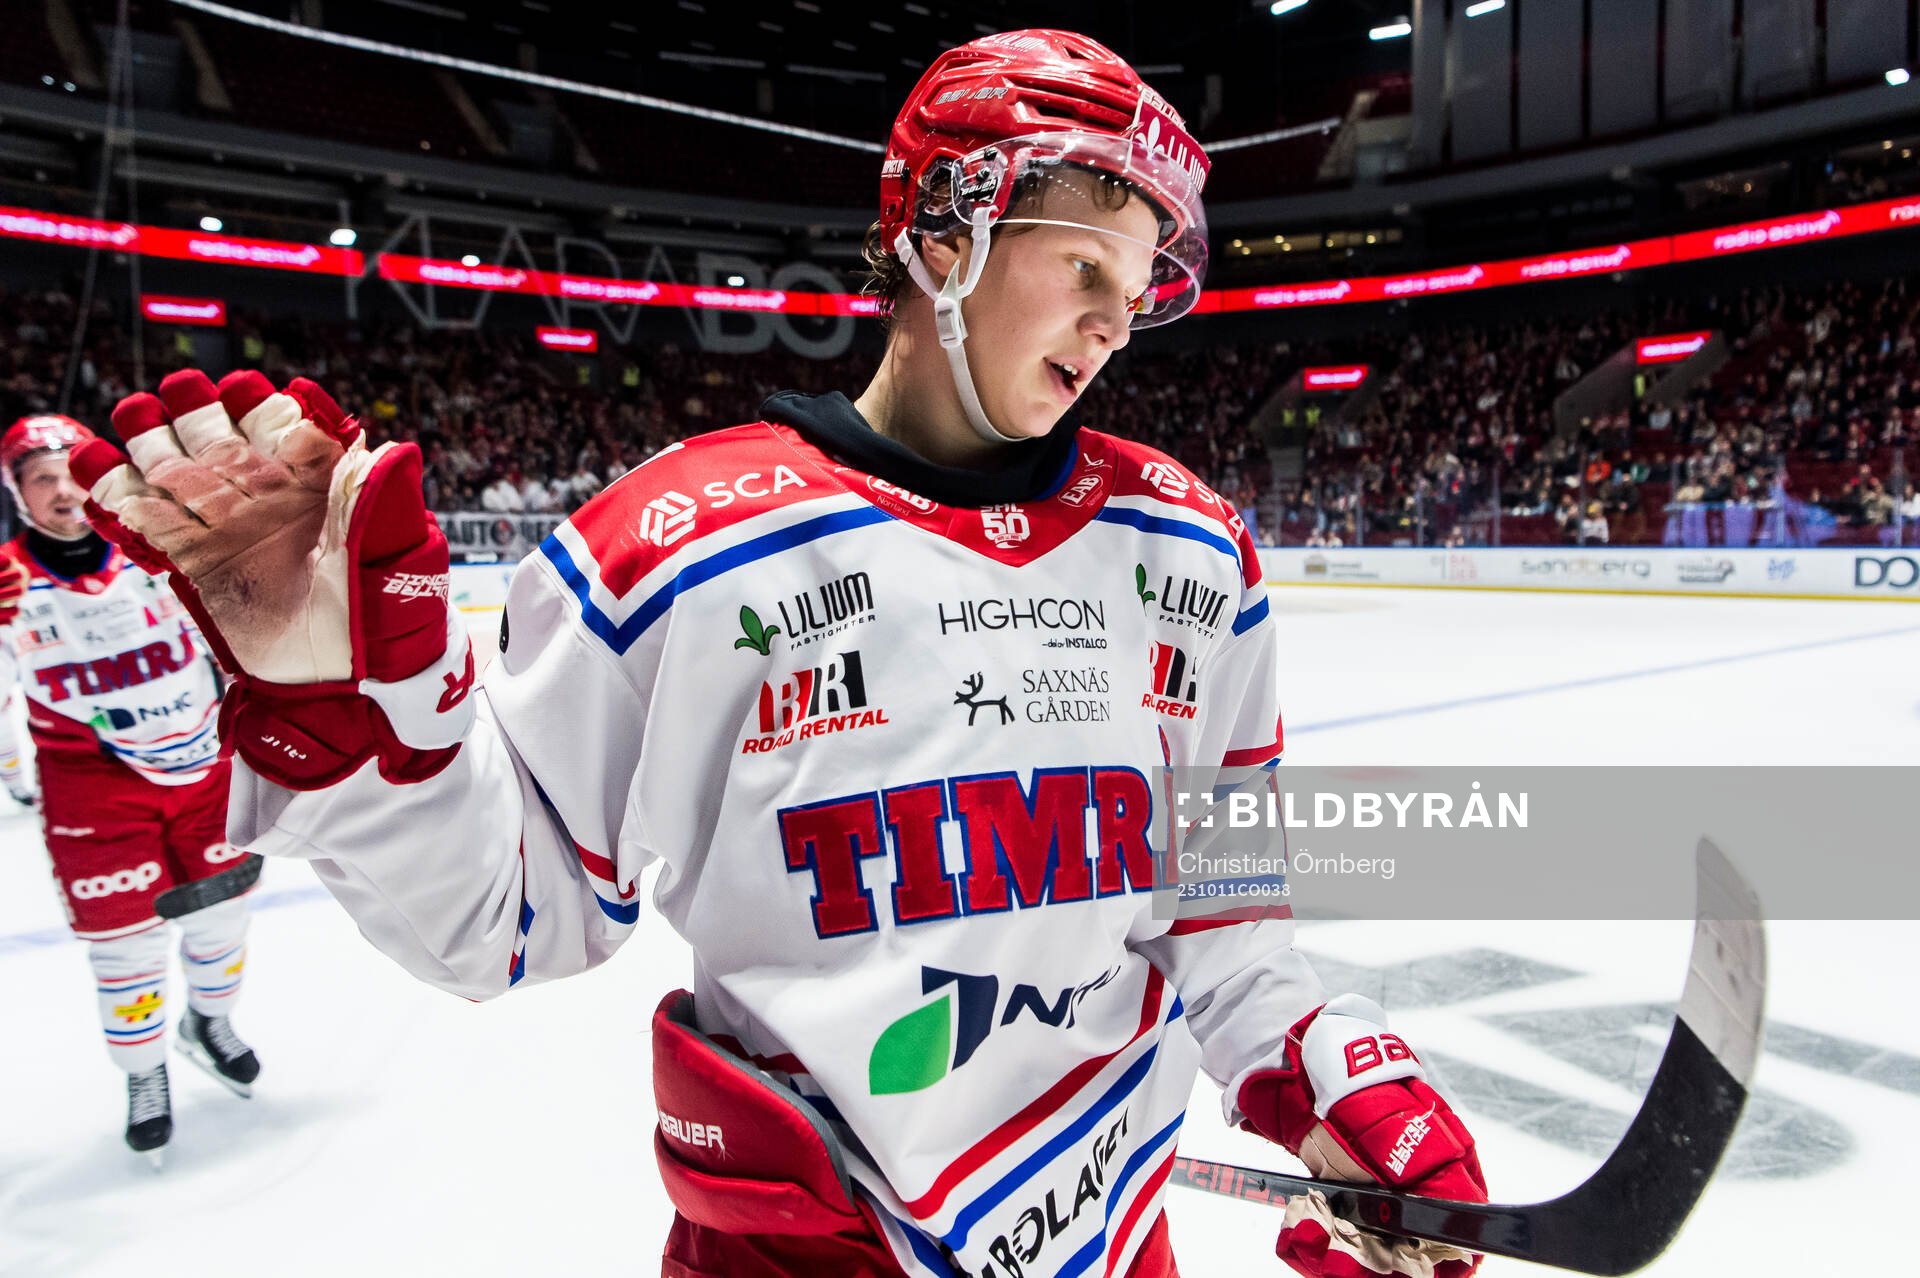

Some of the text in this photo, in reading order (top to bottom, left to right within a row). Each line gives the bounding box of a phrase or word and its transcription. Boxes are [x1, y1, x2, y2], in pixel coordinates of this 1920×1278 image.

[703, 464, 808, 508] SCA
[1061, 477, 1100, 505] EAB
[981, 512, 1031, 541] 50
[778, 571, 874, 639] LILIUM
[938, 598, 1106, 635] HIGHCON
[791, 614, 876, 652] FASTIGHETER
[1065, 637, 1107, 649] INSTALCO
[1023, 667, 1110, 693] SAXNÄS
[1026, 697, 1111, 723] GÅRDEN
[742, 708, 889, 754] ROAD RENTAL
[71, 861, 162, 900] coop
